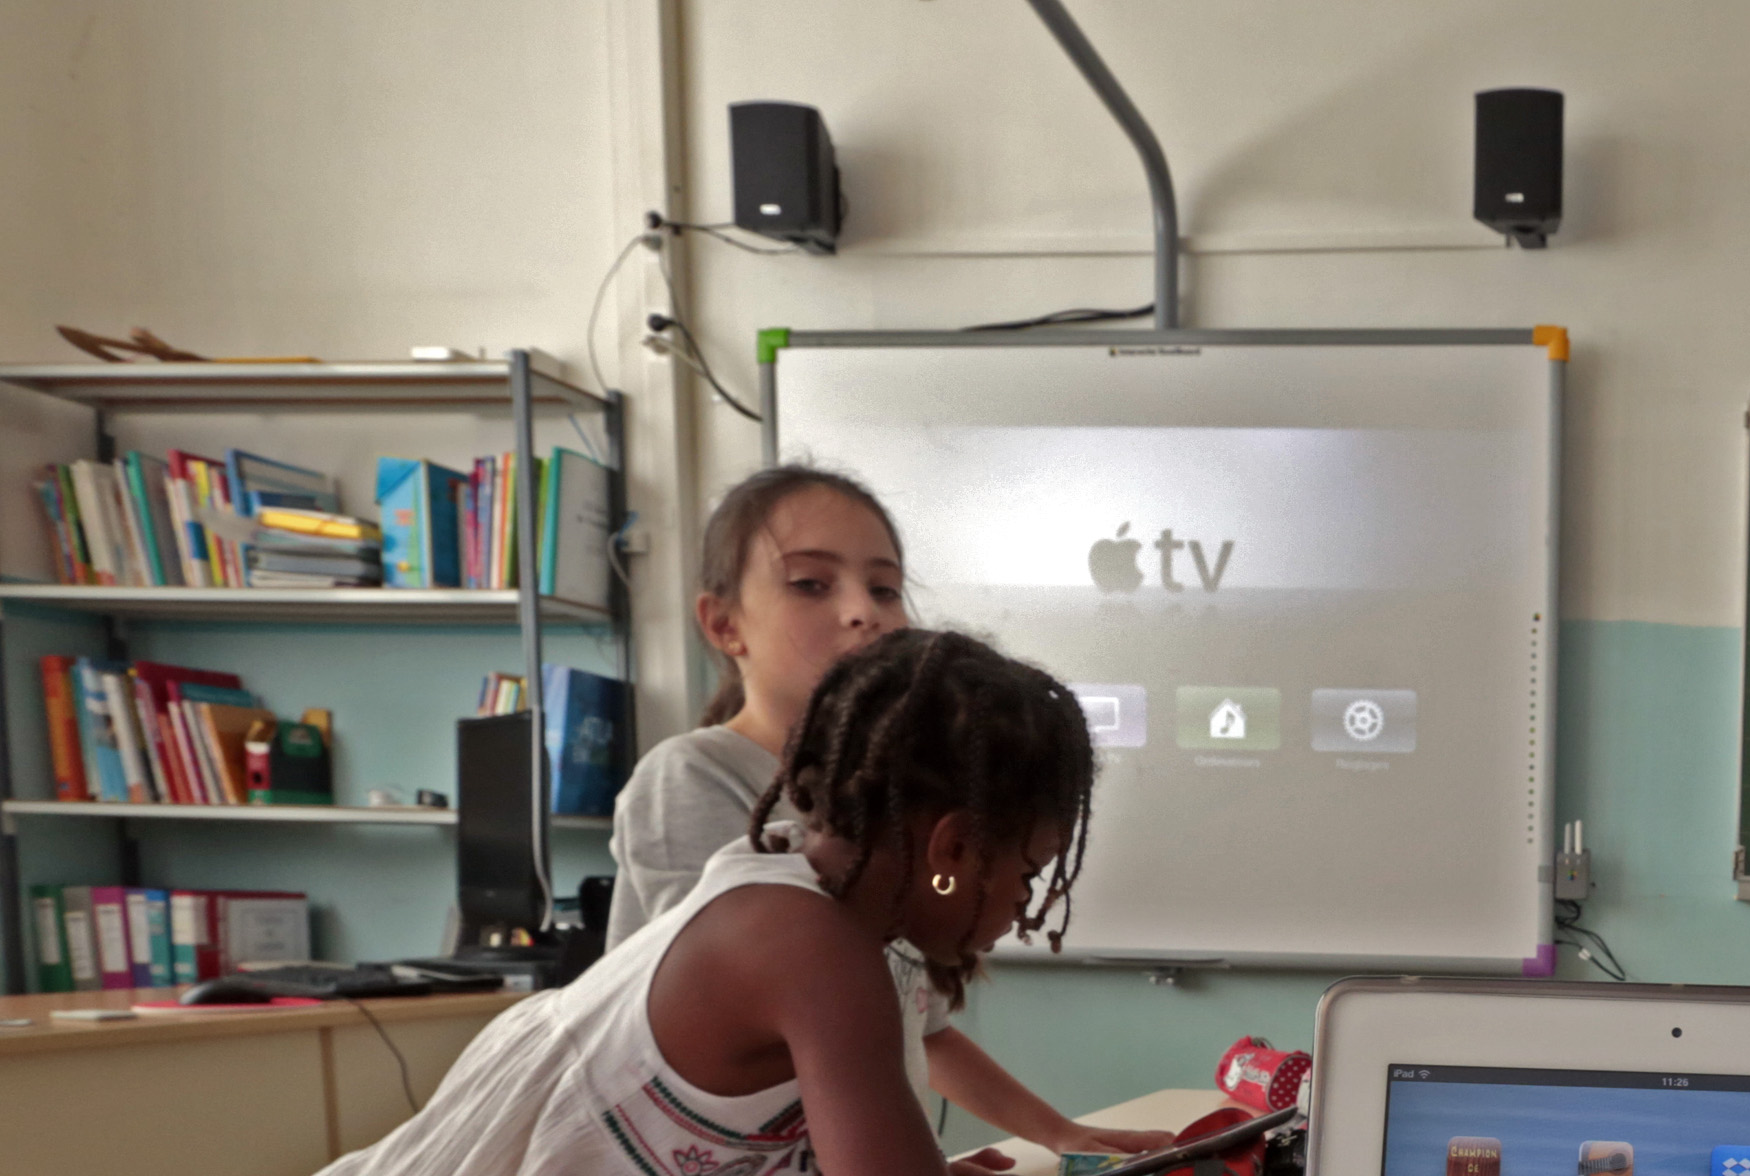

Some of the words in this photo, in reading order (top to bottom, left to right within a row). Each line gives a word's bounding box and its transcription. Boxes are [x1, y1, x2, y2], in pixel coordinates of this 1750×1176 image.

[1155, 528, 1235, 593] tv
[1393, 1068, 1414, 1079] iPad
[1661, 1077, 1689, 1087] 11:26
